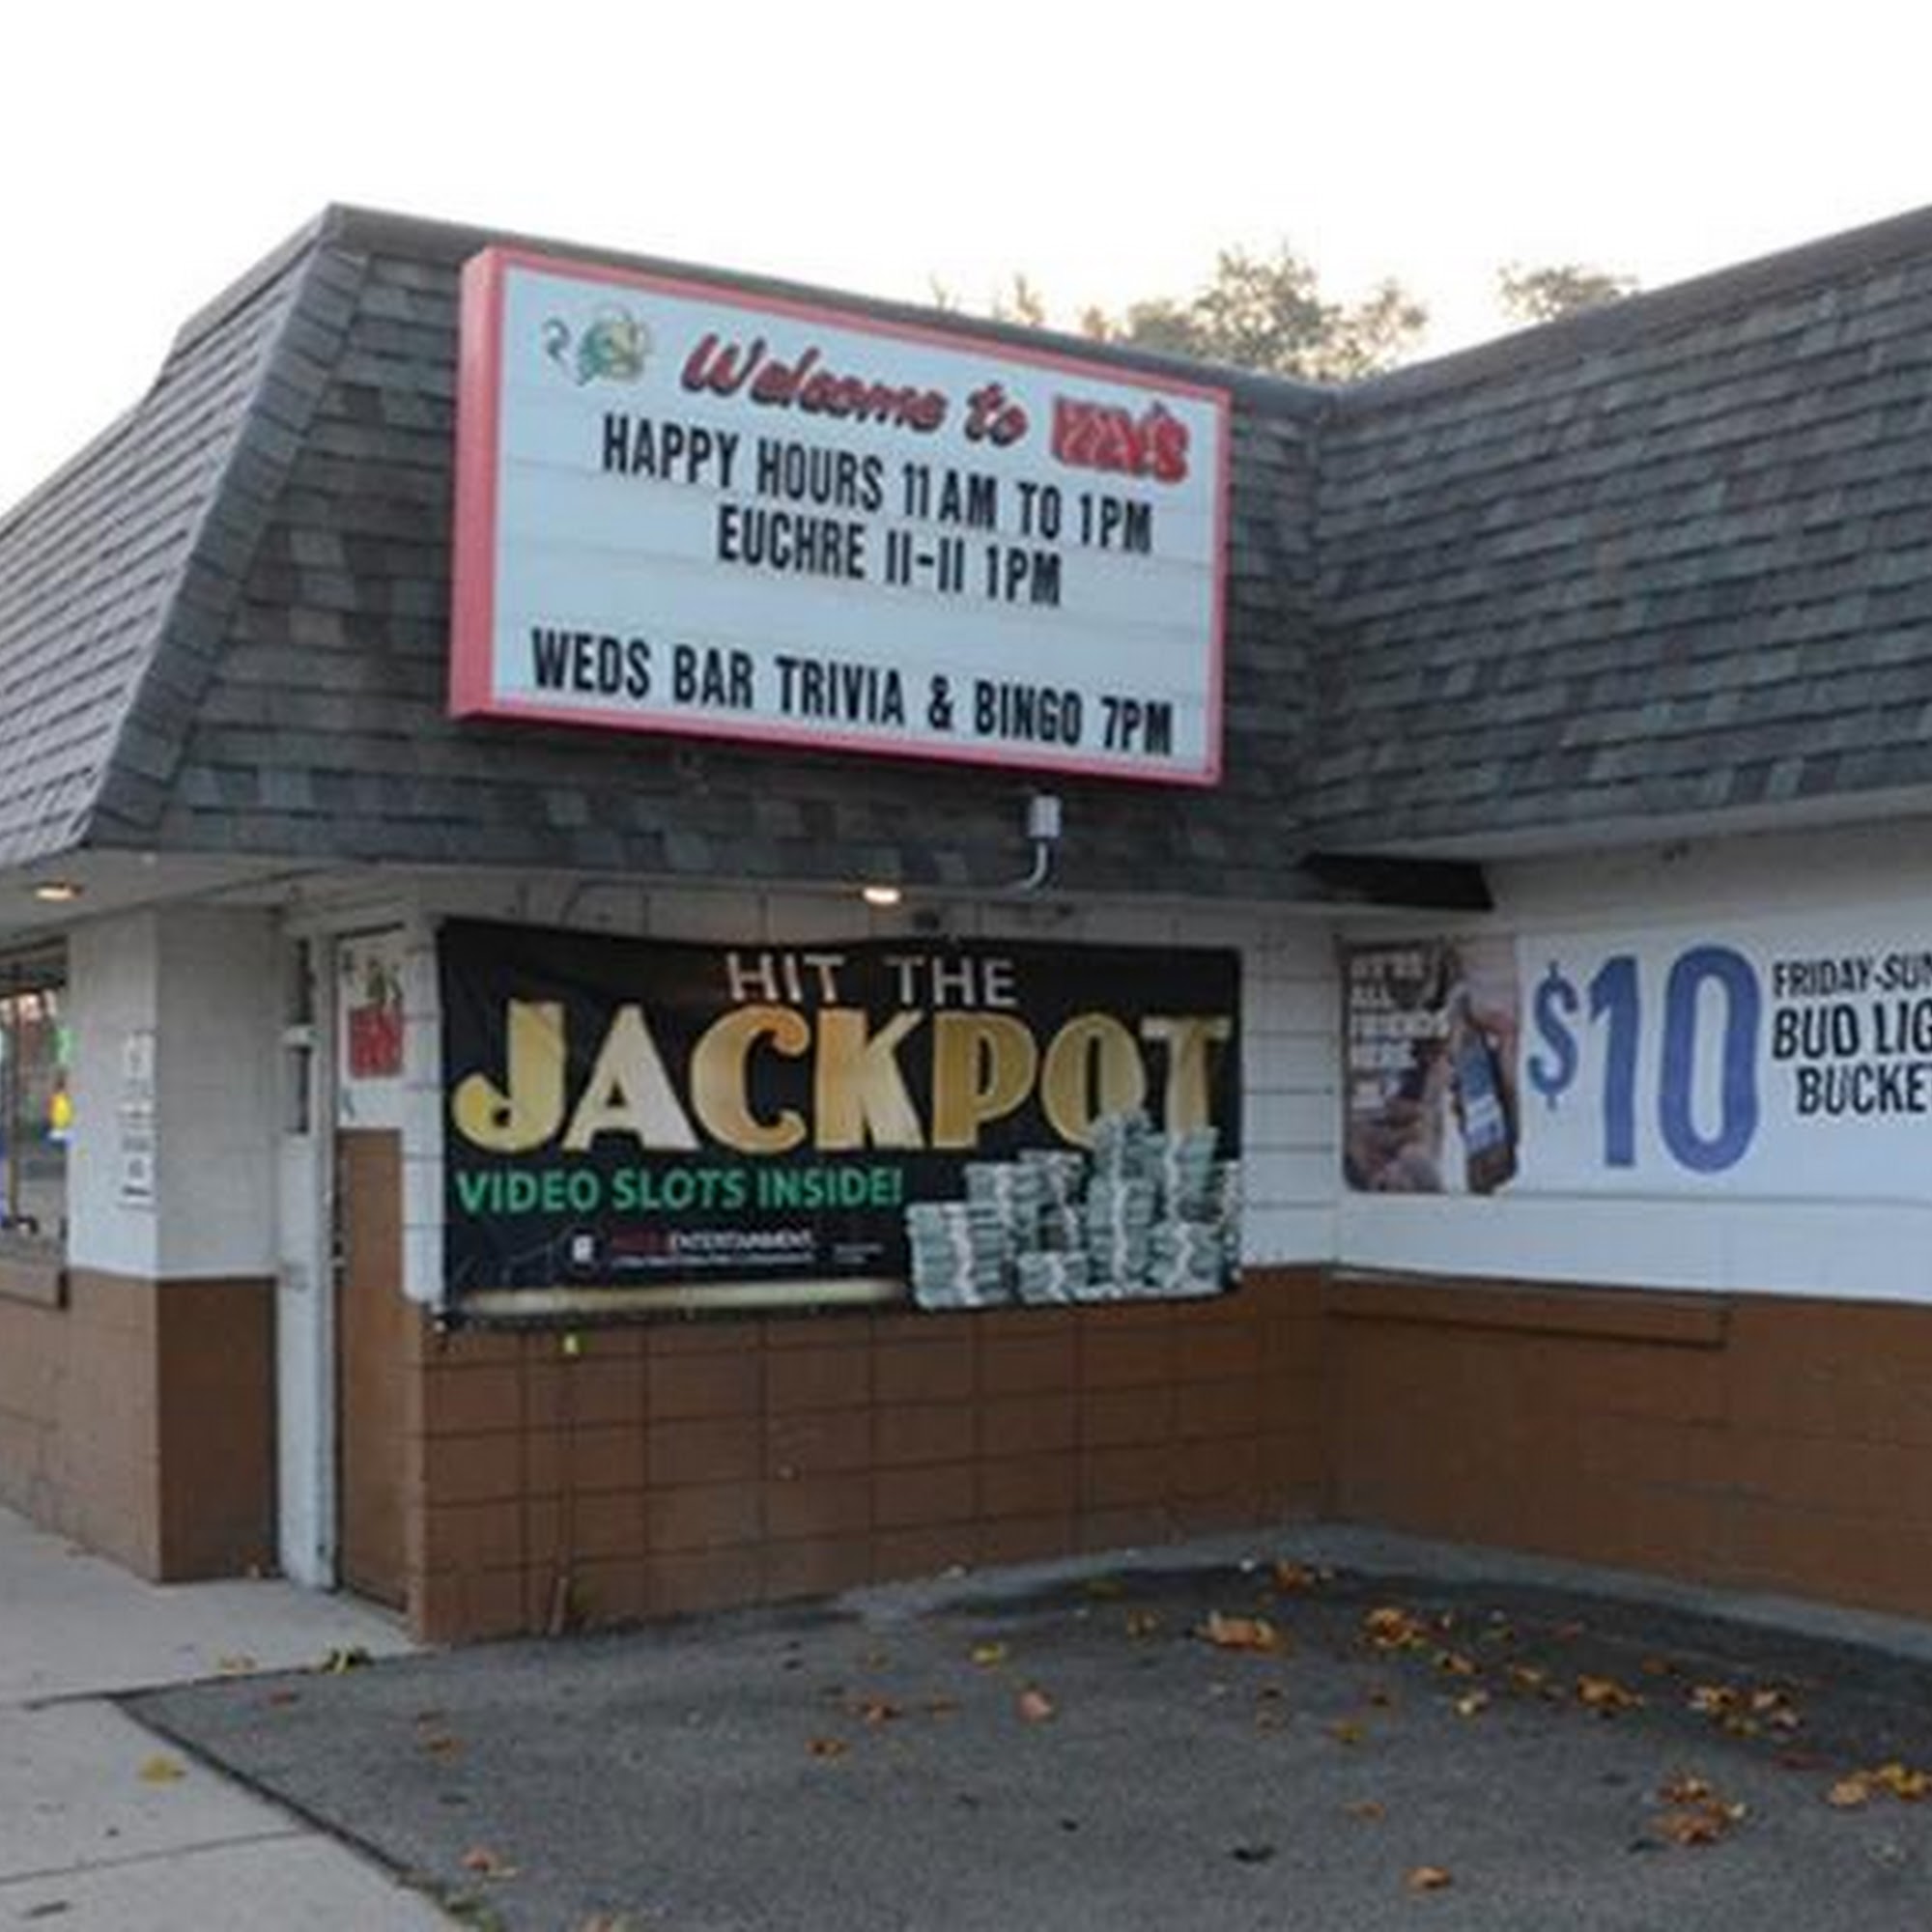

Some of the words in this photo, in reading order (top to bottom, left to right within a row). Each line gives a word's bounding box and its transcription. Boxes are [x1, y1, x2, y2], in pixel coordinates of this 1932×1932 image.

[681, 332, 950, 433] Welcome
[965, 381, 1028, 447] to
[603, 412, 738, 488] HAPPY
[757, 438, 883, 513] HOURS
[1019, 481, 1061, 540] TO
[1080, 494, 1152, 554] 1PM
[718, 504, 866, 579] EUCHRE
[986, 545, 1061, 606] 1PM
[532, 627, 650, 697] WEDS
[674, 643, 753, 710] BAR
[776, 655, 905, 724] TRIVIA
[927, 674, 952, 729] &
[974, 680, 1082, 747] BINGO
[1102, 696, 1172, 755] 7PM
[726, 952, 844, 1002] HIT
[883, 954, 1016, 1006] THE
[1773, 1003, 1860, 1059] BUD
[1873, 998, 1932, 1054] LIG
[452, 998, 1232, 1153] JACKPOT
[1528, 945, 1761, 1174] $10
[1797, 1064, 1932, 1117] BUCKE
[457, 1169, 600, 1212] VIDEO
[611, 1167, 746, 1210] SLOTS
[759, 1166, 902, 1207] INSIDE!
